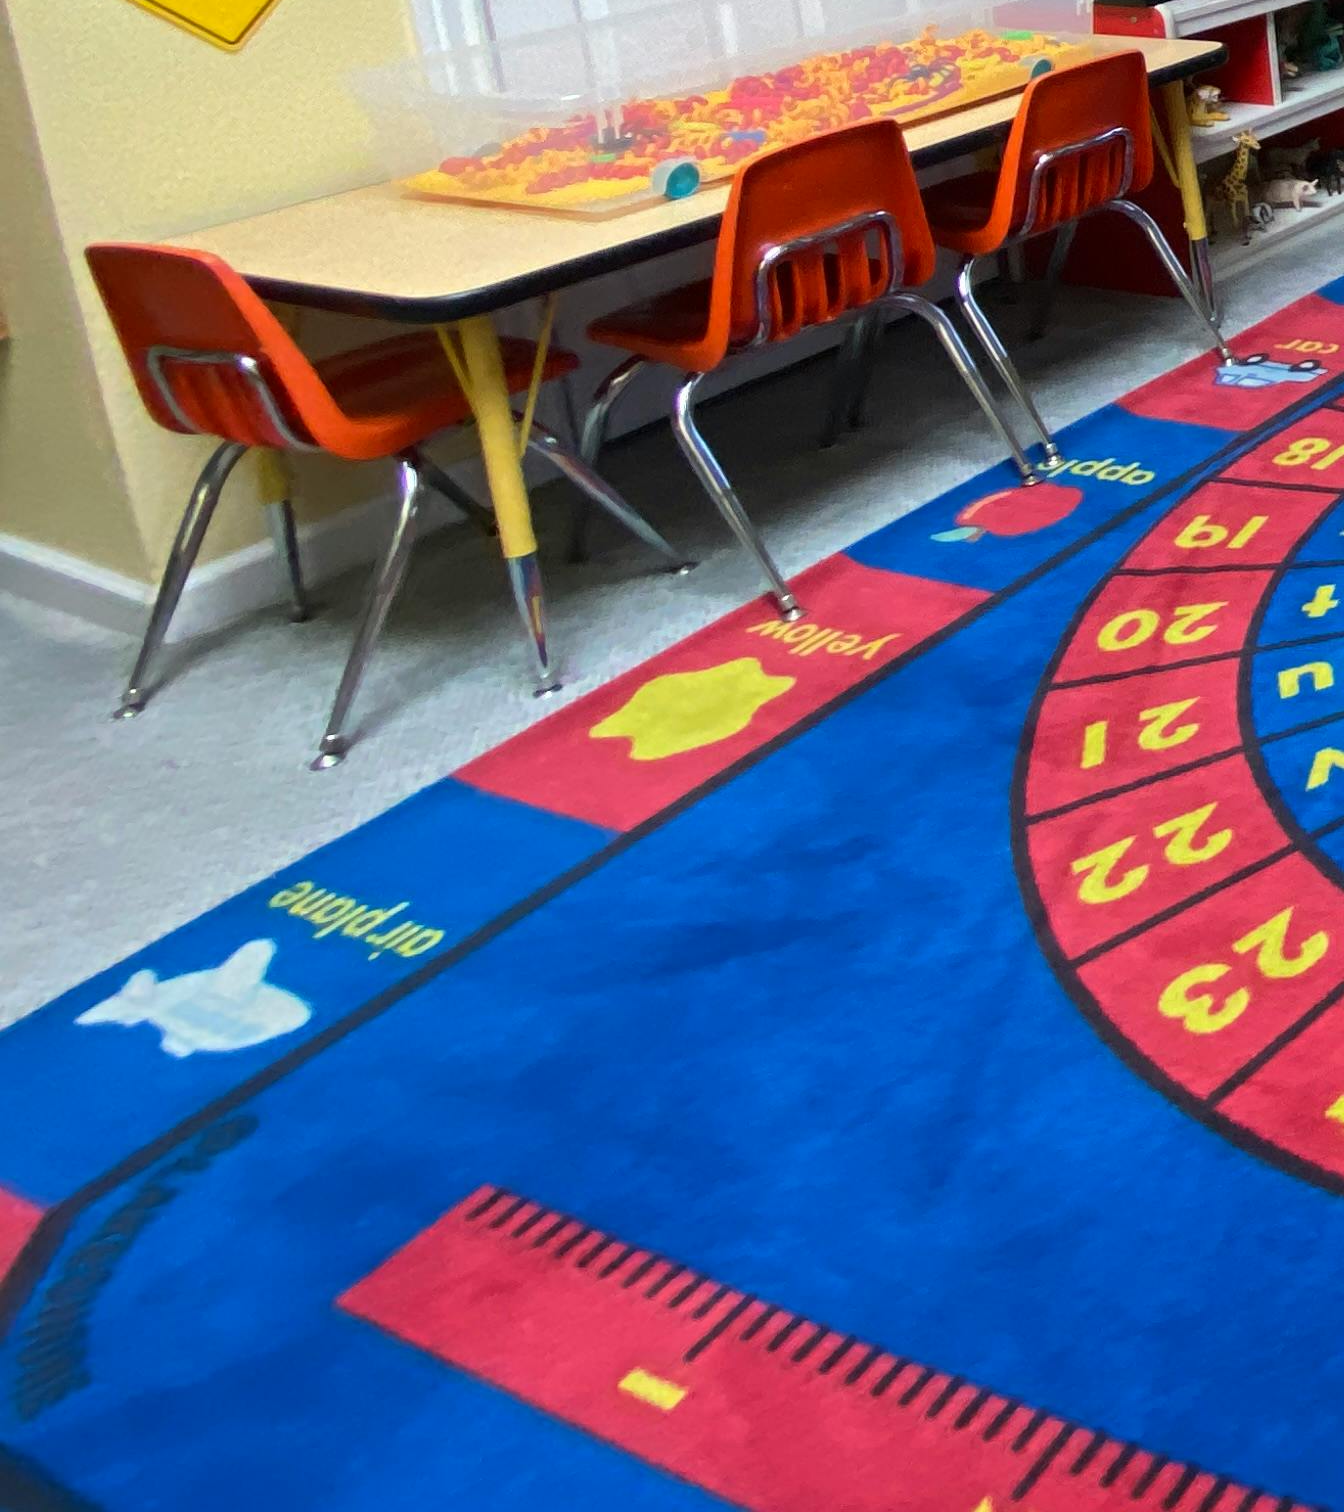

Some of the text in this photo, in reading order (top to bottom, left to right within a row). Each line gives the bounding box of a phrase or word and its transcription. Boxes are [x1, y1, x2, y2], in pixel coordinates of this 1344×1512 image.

[1275, 339, 1341, 355] car
[1174, 514, 1267, 550] 19
[747, 619, 902, 661] yellow
[1097, 601, 1228, 651] 20
[1080, 697, 1199, 770] 21
[1070, 802, 1234, 905] 22
[268, 880, 446, 960] airplane
[1157, 908, 1330, 1035] 23
